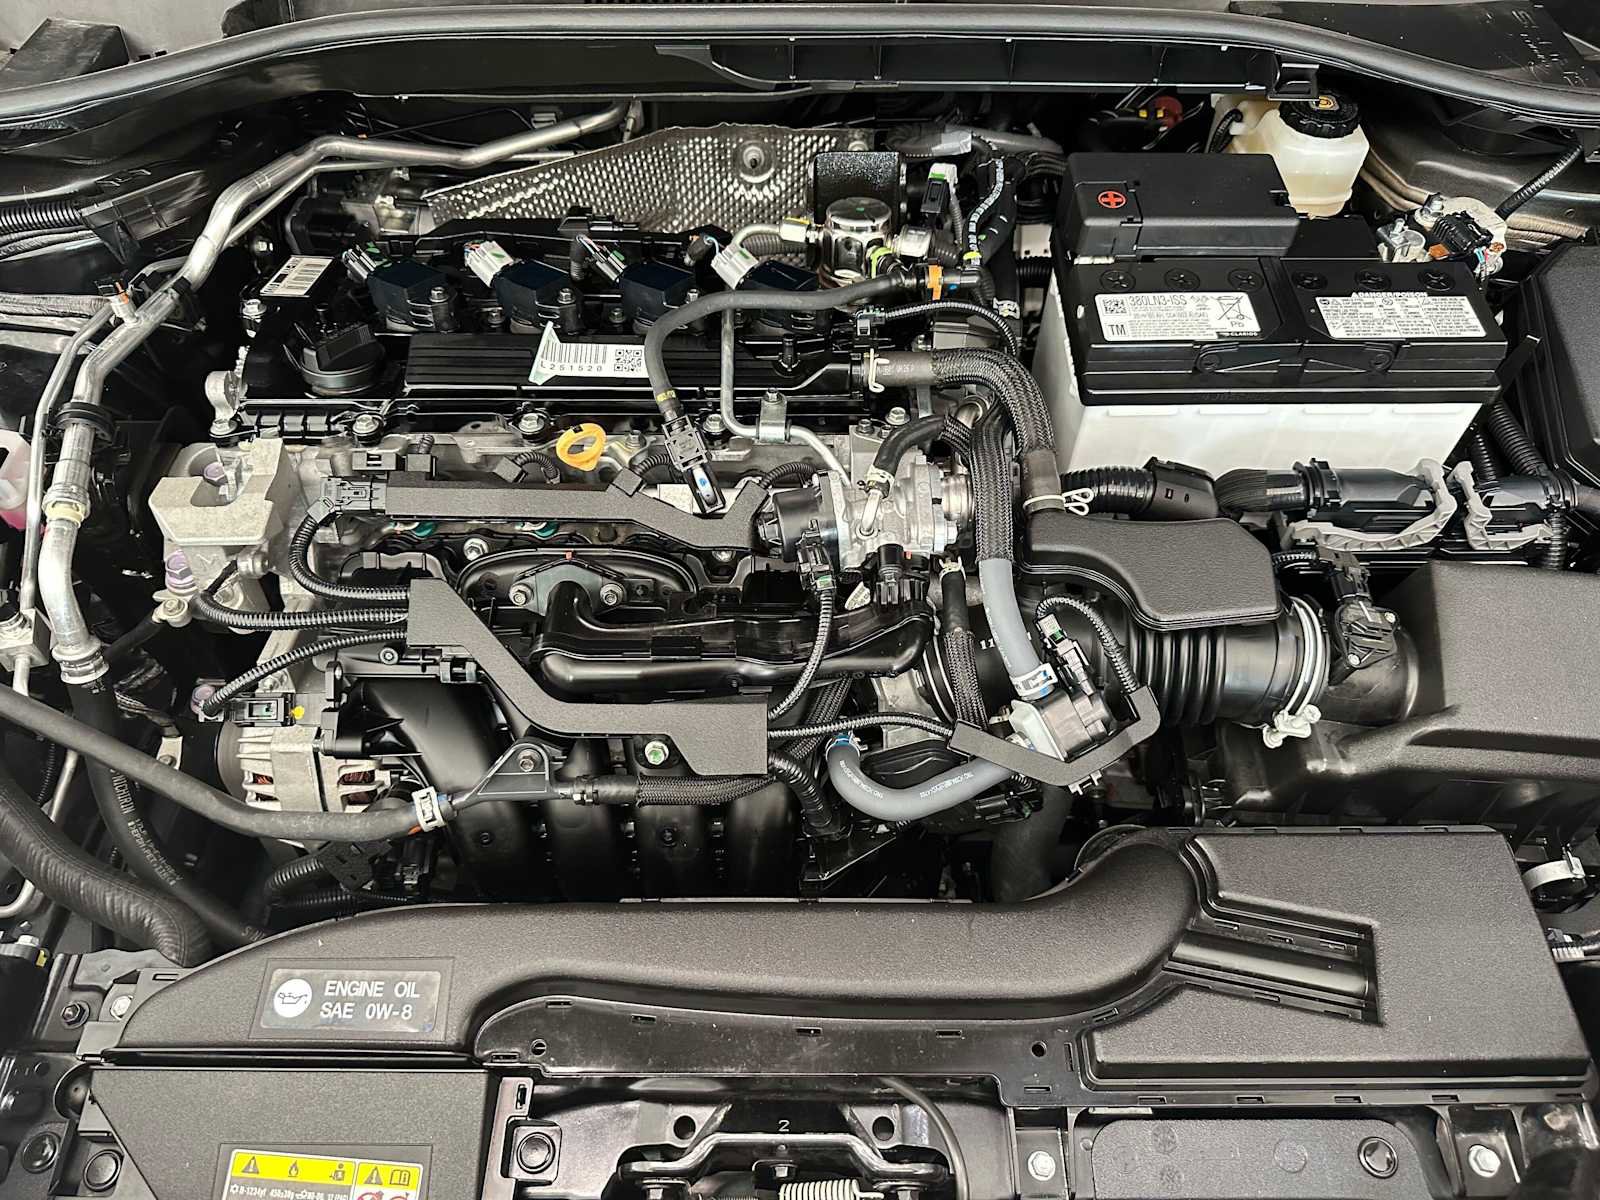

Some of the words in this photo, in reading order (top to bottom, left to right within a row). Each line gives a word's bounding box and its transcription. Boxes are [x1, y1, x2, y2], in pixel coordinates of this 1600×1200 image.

[1108, 324, 1126, 336] TM
[324, 980, 385, 998] ENGINE
[394, 981, 421, 998] OIL
[319, 1001, 355, 1019] SAE
[365, 1003, 413, 1020] 0W-8
[778, 1119, 790, 1132] 2
